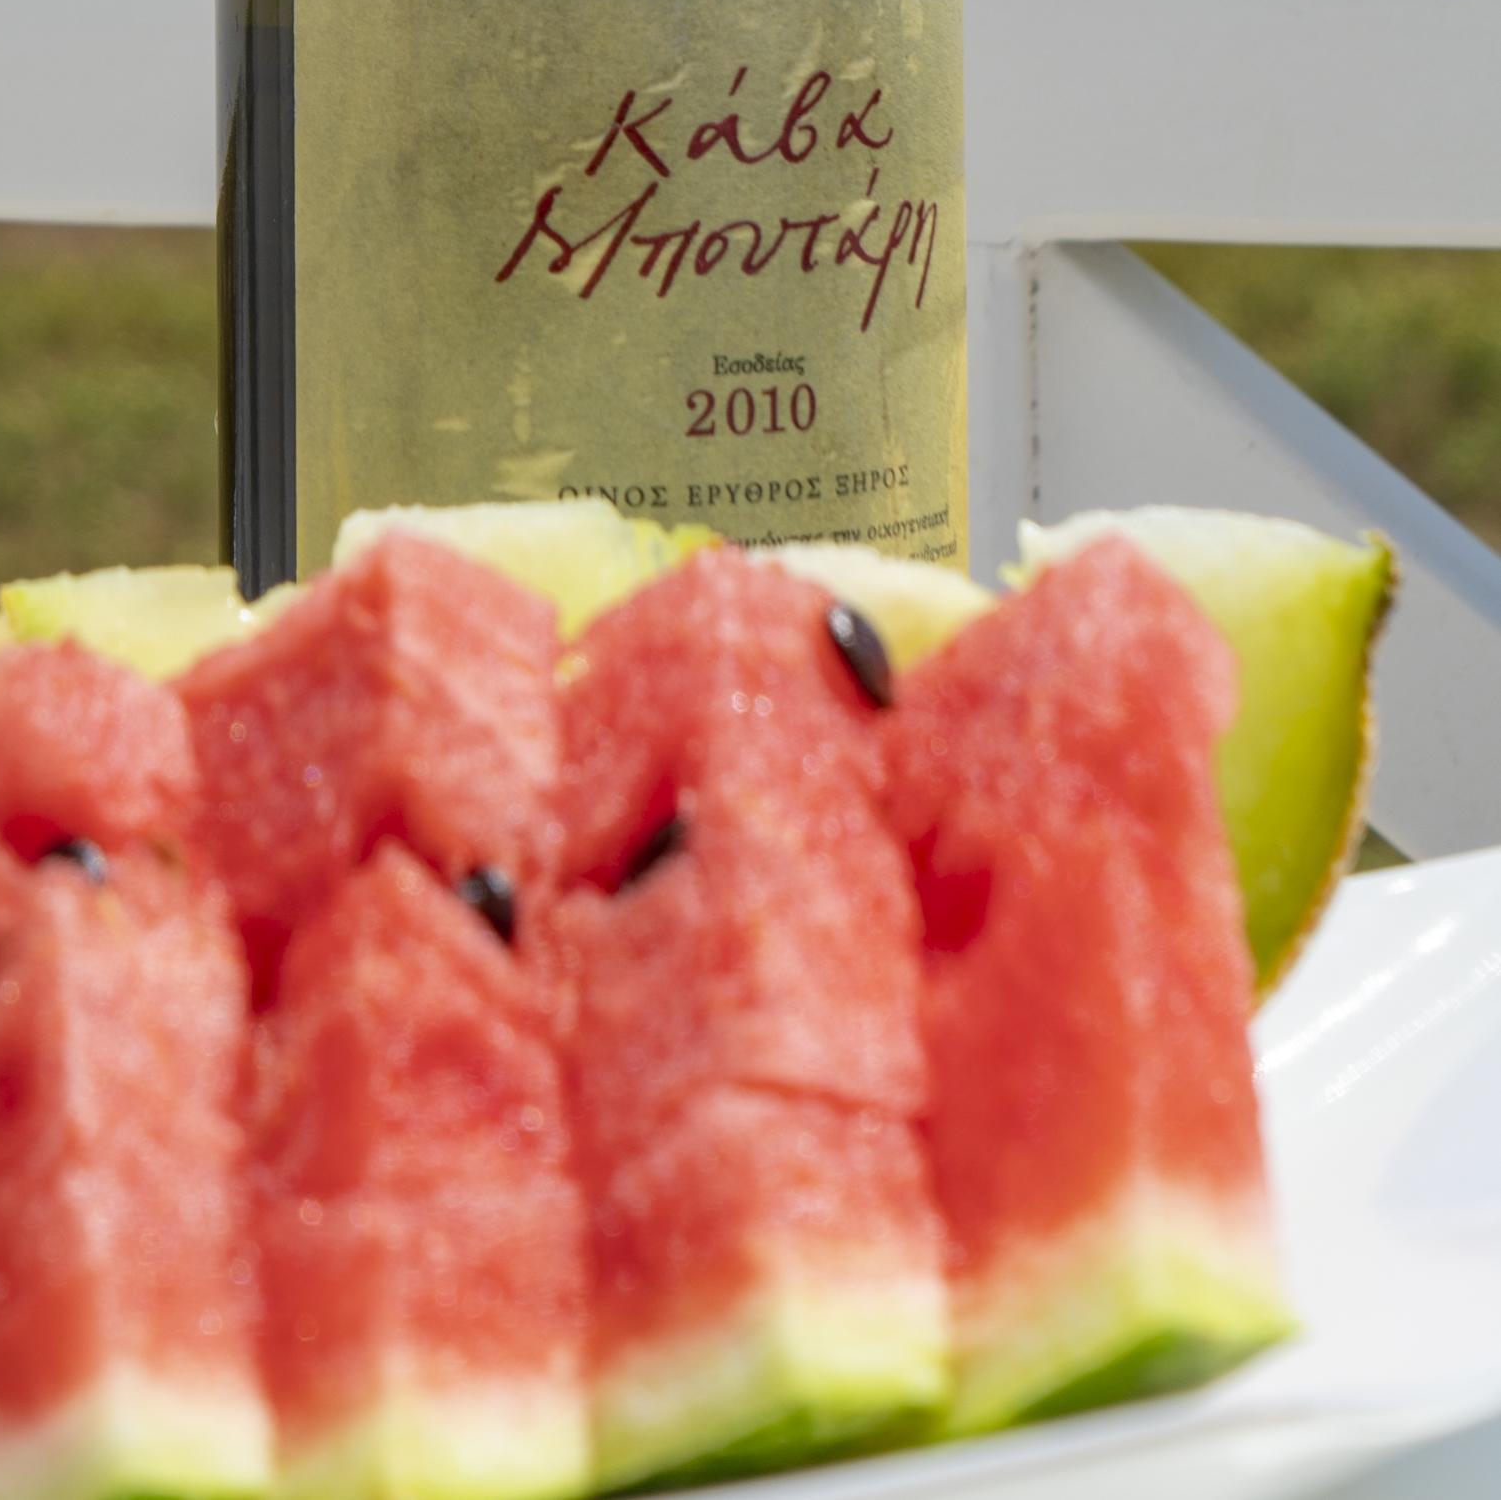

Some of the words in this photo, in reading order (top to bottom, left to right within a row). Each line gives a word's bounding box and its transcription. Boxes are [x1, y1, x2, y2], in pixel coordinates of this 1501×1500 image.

[495, 167, 937, 332] Μπουτάρη
[713, 352, 805, 375] Εσοδείας
[686, 383, 816, 437] 2010
[687, 477, 822, 507] ΕΡΥΘΡΟΣ
[836, 465, 910, 497] ΞΗΡΟΣ
